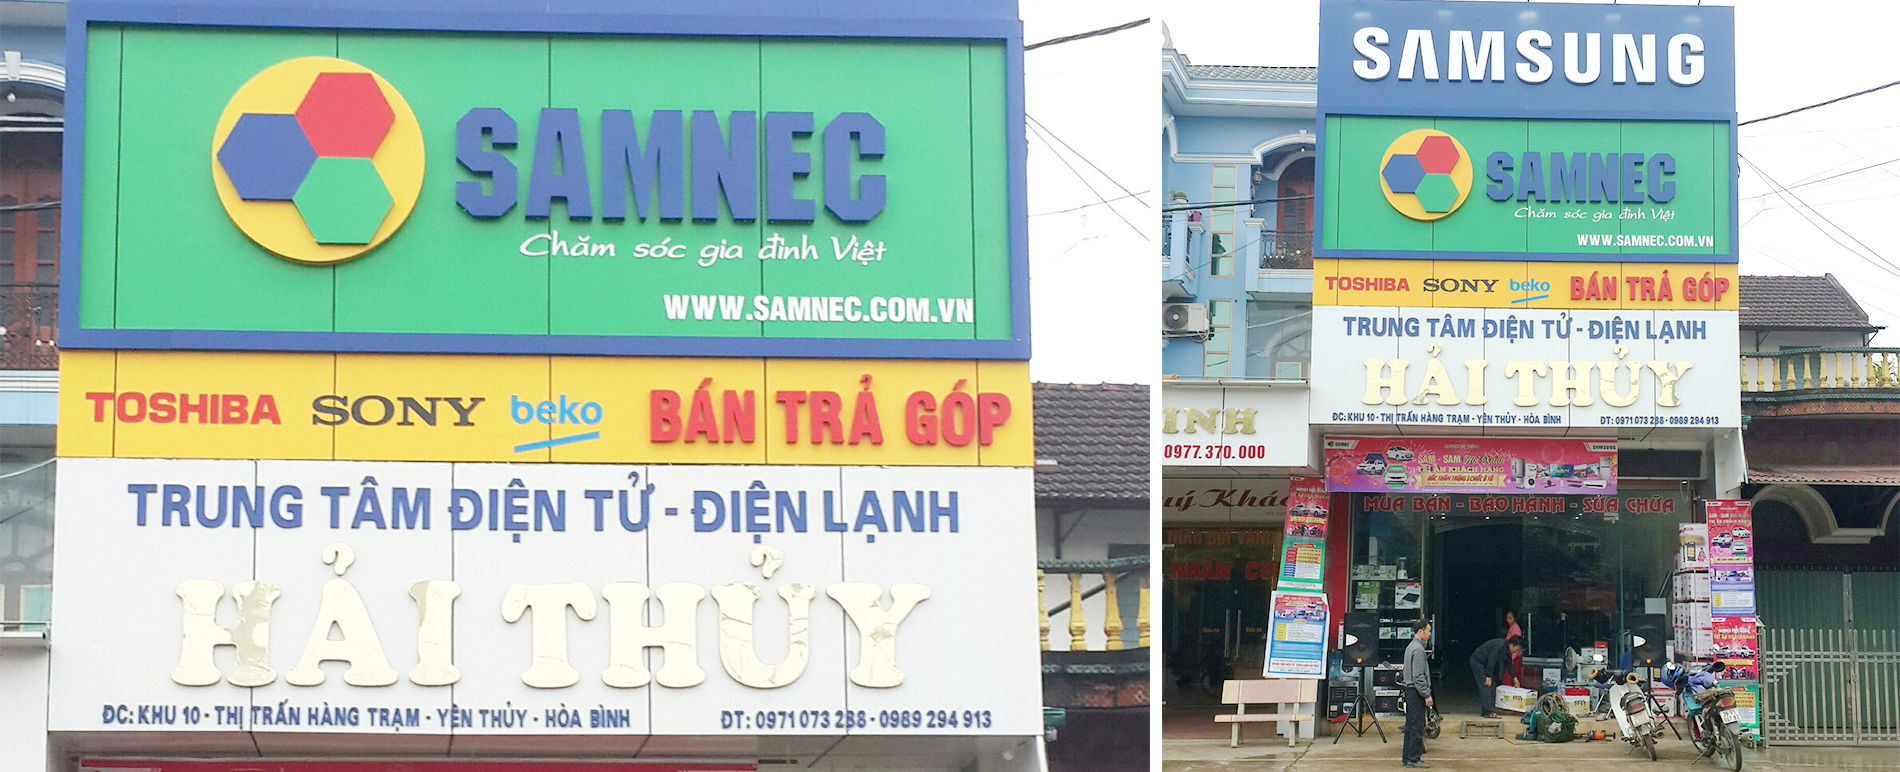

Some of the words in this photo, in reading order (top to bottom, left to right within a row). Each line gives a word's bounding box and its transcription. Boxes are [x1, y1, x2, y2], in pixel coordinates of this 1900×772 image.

[1352, 26, 1705, 86] SAMSUNG
[455, 107, 887, 224] SAMNEC
[1486, 151, 1677, 204] SAMNEC
[1514, 206, 1557, 219] Chăm
[1564, 209, 1588, 219] sóc
[1592, 210, 1613, 222] gia
[1618, 207, 1646, 220] đình
[1651, 208, 1676, 222] Việt
[519, 230, 616, 258] Chăm
[632, 236, 687, 259] sóc
[696, 238, 744, 267] gia
[757, 231, 819, 261] đình
[830, 234, 887, 267] Việt
[1577, 234, 1714, 248] WWW.SAMNEC.COM.VN
[1325, 276, 1411, 292] TOSHIBA
[1423, 278, 1499, 293] SONY
[1509, 278, 1551, 293] beko
[1570, 271, 1617, 301] BÁN
[1625, 269, 1673, 301] TRẢ
[1682, 271, 1730, 302] GÓP
[663, 293, 975, 324] WWW.SAMNEC.COM.VN
[1343, 316, 1420, 337] TRUNG
[1427, 313, 1476, 338] TÂM
[1482, 315, 1534, 343] ĐIỆN
[1541, 312, 1573, 339] TỬ
[1588, 316, 1640, 344] ĐIỆN
[1646, 320, 1706, 344] LẠNH
[1361, 342, 1489, 406] HẢI
[1504, 344, 1694, 408] THỦY
[85, 391, 282, 426] TOSHIBA
[311, 395, 486, 427] SONY
[510, 394, 603, 426] beko
[649, 377, 756, 444] BÁN
[775, 373, 885, 445] TRẢ
[904, 378, 1012, 448] GÓP
[1162, 406, 1258, 435] INH
[1332, 412, 1346, 422] ĐC:
[1347, 412, 1365, 422] KHU
[1367, 412, 1375, 422] 10
[1381, 412, 1394, 423] THỊ
[1396, 411, 1418, 422] TRẤN
[1420, 411, 1444, 423] HÀNG
[1446, 414, 1470, 425] TRẠM
[1476, 412, 1493, 424] YÊN
[1495, 411, 1516, 424] THỦY
[1523, 412, 1540, 424] HÒA
[1543, 412, 1562, 424] BÌNH
[1600, 416, 1614, 425] ĐT:
[1615, 416, 1633, 425] 0971
[1634, 416, 1648, 425] 073
[1669, 416, 1689, 425] 0989
[1690, 416, 1704, 425] 294
[1705, 416, 1719, 425] 913
[1163, 444, 1266, 460] 0977.370.000
[1418, 454, 1436, 464] SAM
[1443, 454, 1461, 464] SAM
[128, 483, 303, 528] TRUNG
[321, 475, 432, 531] TÂM
[448, 478, 566, 543] ĐIỆN
[584, 471, 656, 532] TỬ
[690, 480, 807, 544] ĐIỆN
[823, 489, 960, 543] LẠNH
[1162, 489, 1197, 512] uý
[1364, 495, 1405, 512] MUA
[1411, 492, 1451, 513] BÁN
[1469, 493, 1509, 513] BẢO
[1511, 494, 1565, 514] HÀNH
[1582, 496, 1620, 514] SỬA
[1625, 495, 1675, 514] CHỮA
[1244, 560, 1280, 580] CƯ
[170, 542, 462, 688] HẢI
[500, 545, 932, 689] THỦY
[101, 704, 135, 726] ĐC:
[138, 704, 177, 725] KHU
[182, 704, 202, 725] 10
[215, 705, 244, 730] THỊ
[250, 698, 301, 726] TRẤN
[308, 701, 360, 727] HÀNG
[367, 706, 420, 732] TRẠM
[436, 703, 473, 729] YÊN
[479, 701, 528, 729] THỦY
[545, 704, 582, 729] HÒA
[591, 704, 631, 729] BÌNH
[720, 710, 751, 730] ĐT:
[756, 710, 797, 729] 0971
[799, 710, 831, 729] 073
[835, 710, 867, 729] 288
[879, 710, 922, 729] 0989
[926, 710, 959, 728] 294
[962, 710, 992, 728] 913
